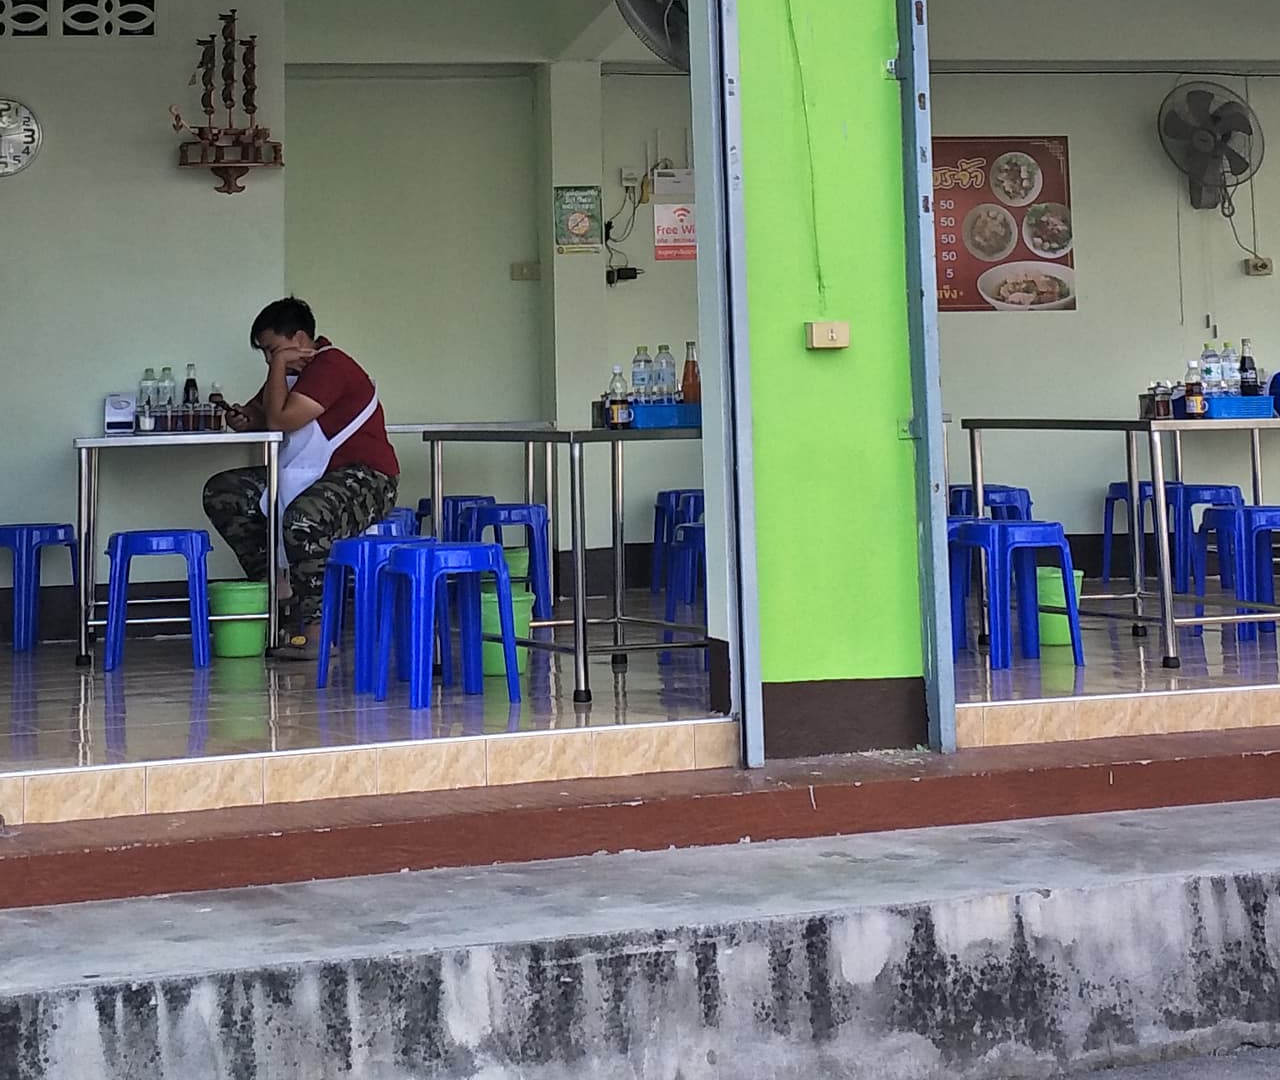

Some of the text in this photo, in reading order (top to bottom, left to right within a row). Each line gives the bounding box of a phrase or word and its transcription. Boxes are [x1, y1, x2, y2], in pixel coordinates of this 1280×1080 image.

[24, 129, 35, 144] 3
[22, 146, 30, 155] 4
[940, 200, 954, 210] 50
[940, 217, 955, 227] 50
[656, 224, 679, 235] Free
[941, 234, 956, 244] 50
[942, 251, 957, 261] 50
[946, 268, 955, 279] 5
